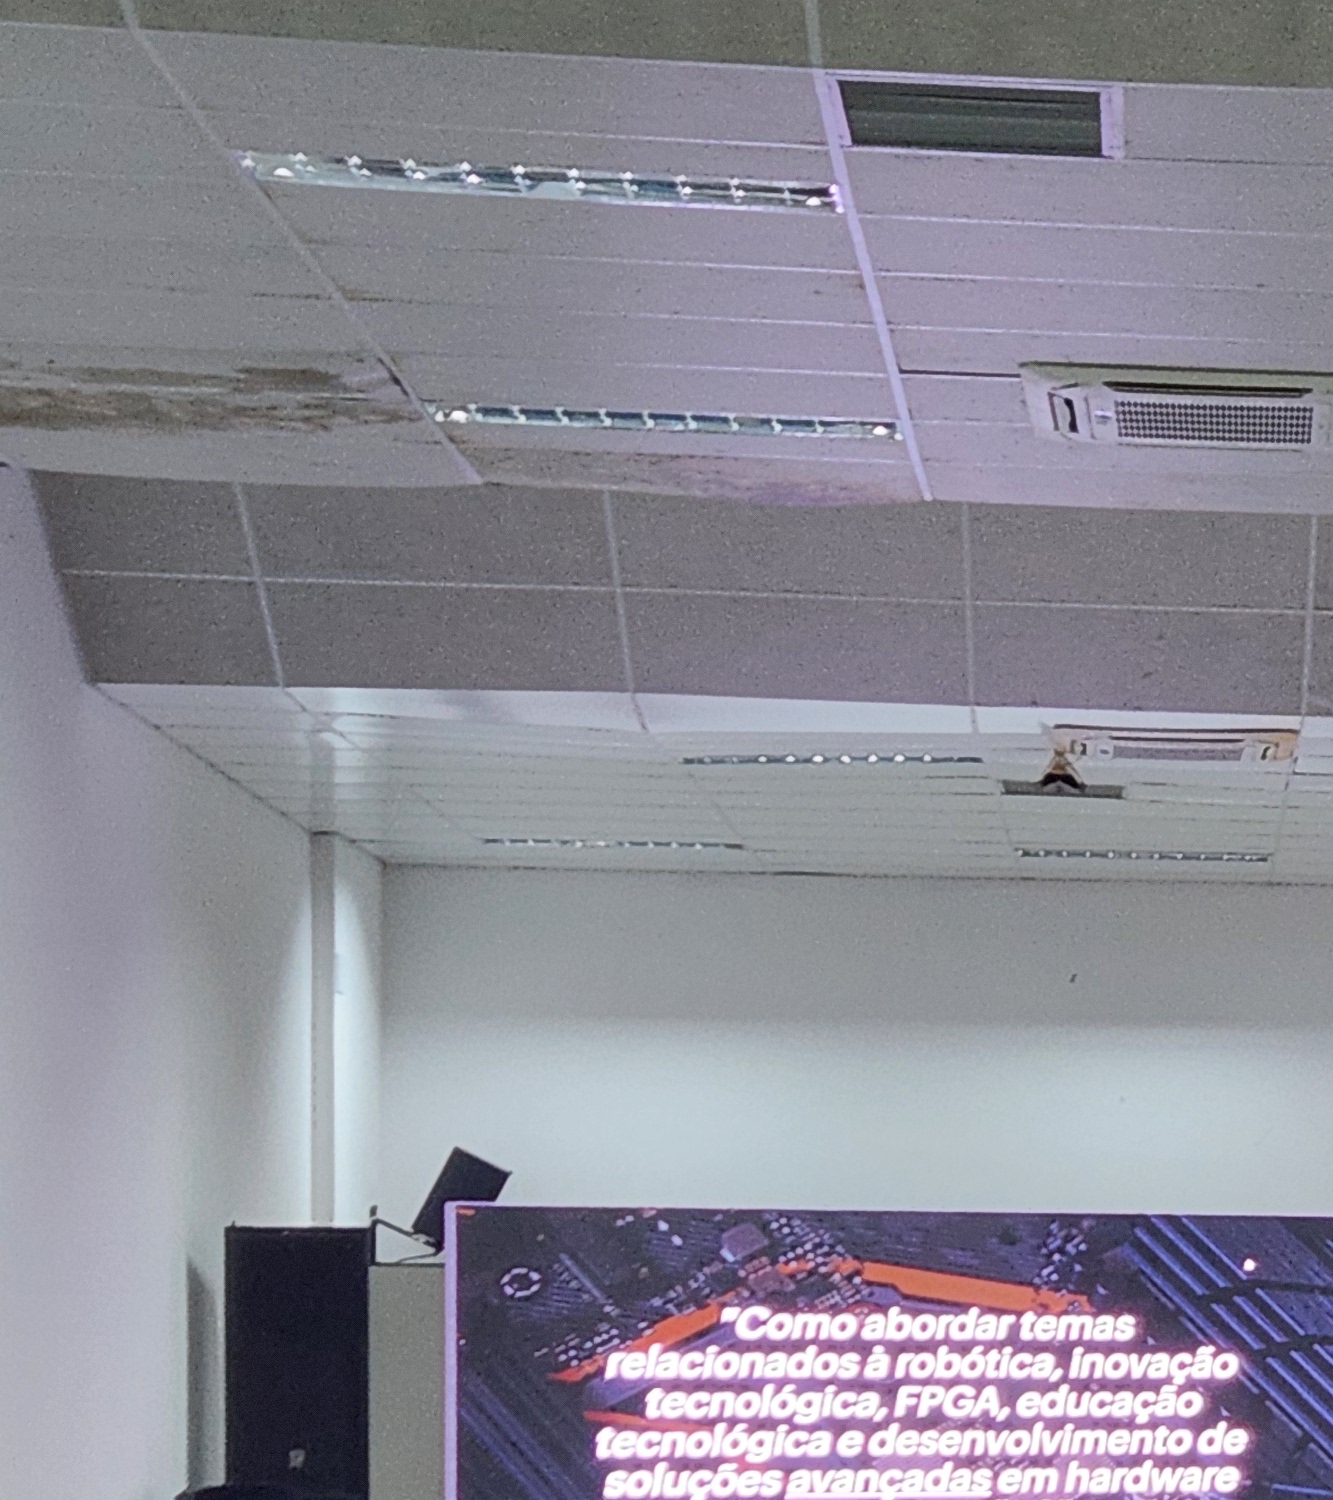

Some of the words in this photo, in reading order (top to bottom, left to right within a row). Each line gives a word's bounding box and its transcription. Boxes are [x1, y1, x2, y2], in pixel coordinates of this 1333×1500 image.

[720, 1305, 858, 1341] "Como
[861, 1306, 1016, 1342] abordar
[1019, 1310, 1135, 1342] temas
[604, 1342, 861, 1380] relacionados
[863, 1345, 891, 1379] à
[894, 1344, 1064, 1382] robótica,
[1068, 1345, 1240, 1385] inovação
[644, 1382, 889, 1424] tecnológica,
[894, 1384, 1011, 1420] FPGA,
[1015, 1383, 1206, 1423] educação
[595, 1422, 834, 1462] tecnológica
[835, 1429, 865, 1458] e
[867, 1422, 1193, 1457] desenvolvimento
[1196, 1420, 1250, 1456] de
[996, 1466, 1059, 1494] em
[1064, 1460, 1240, 1494] hardware
